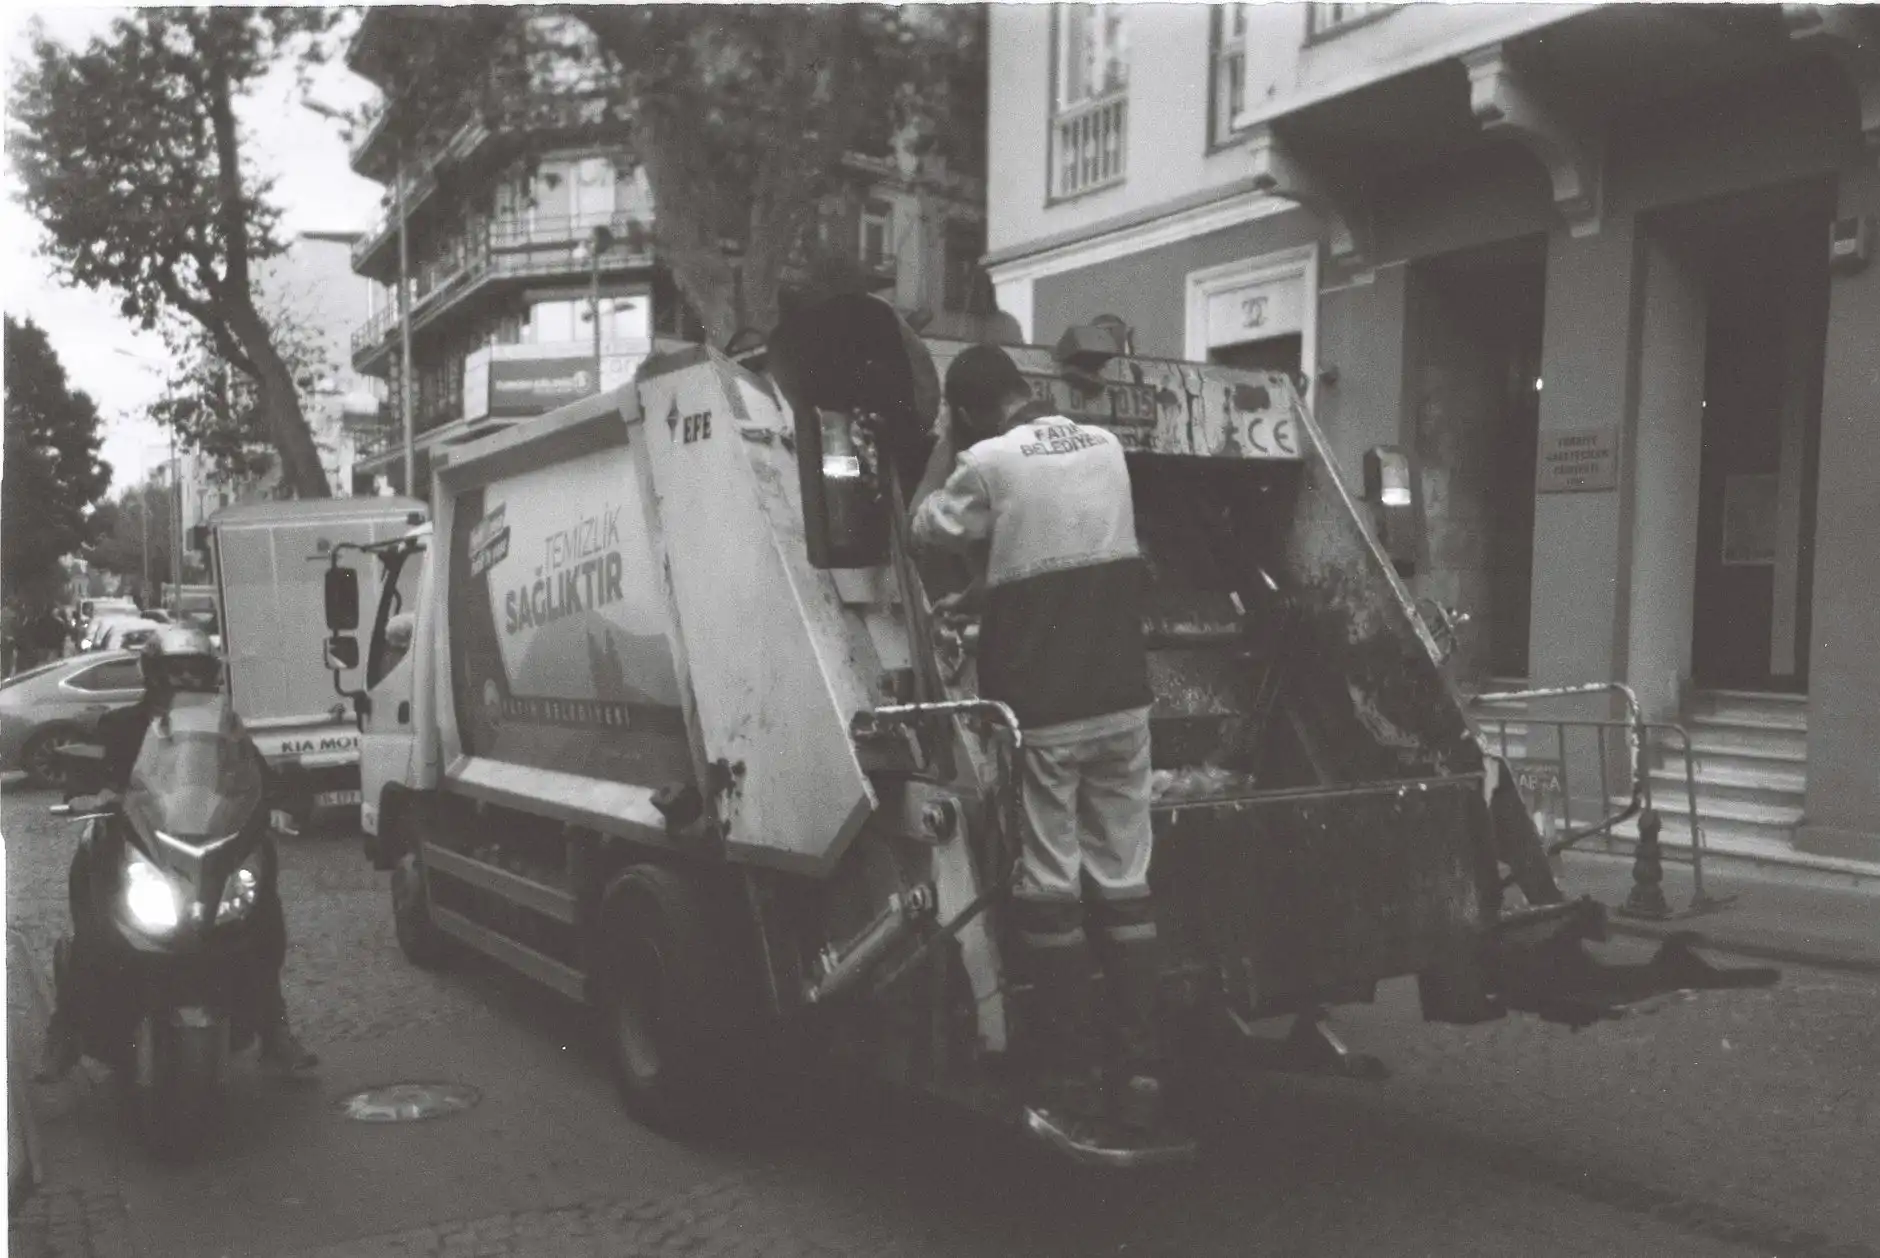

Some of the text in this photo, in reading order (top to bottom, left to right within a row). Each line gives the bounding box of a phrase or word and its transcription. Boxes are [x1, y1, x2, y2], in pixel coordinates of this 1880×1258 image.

[683, 411, 712, 444] EFE
[545, 502, 621, 573] TEMİZLİK
[505, 551, 624, 635] SAĞLIKTIR
[282, 740, 314, 753] KIA
